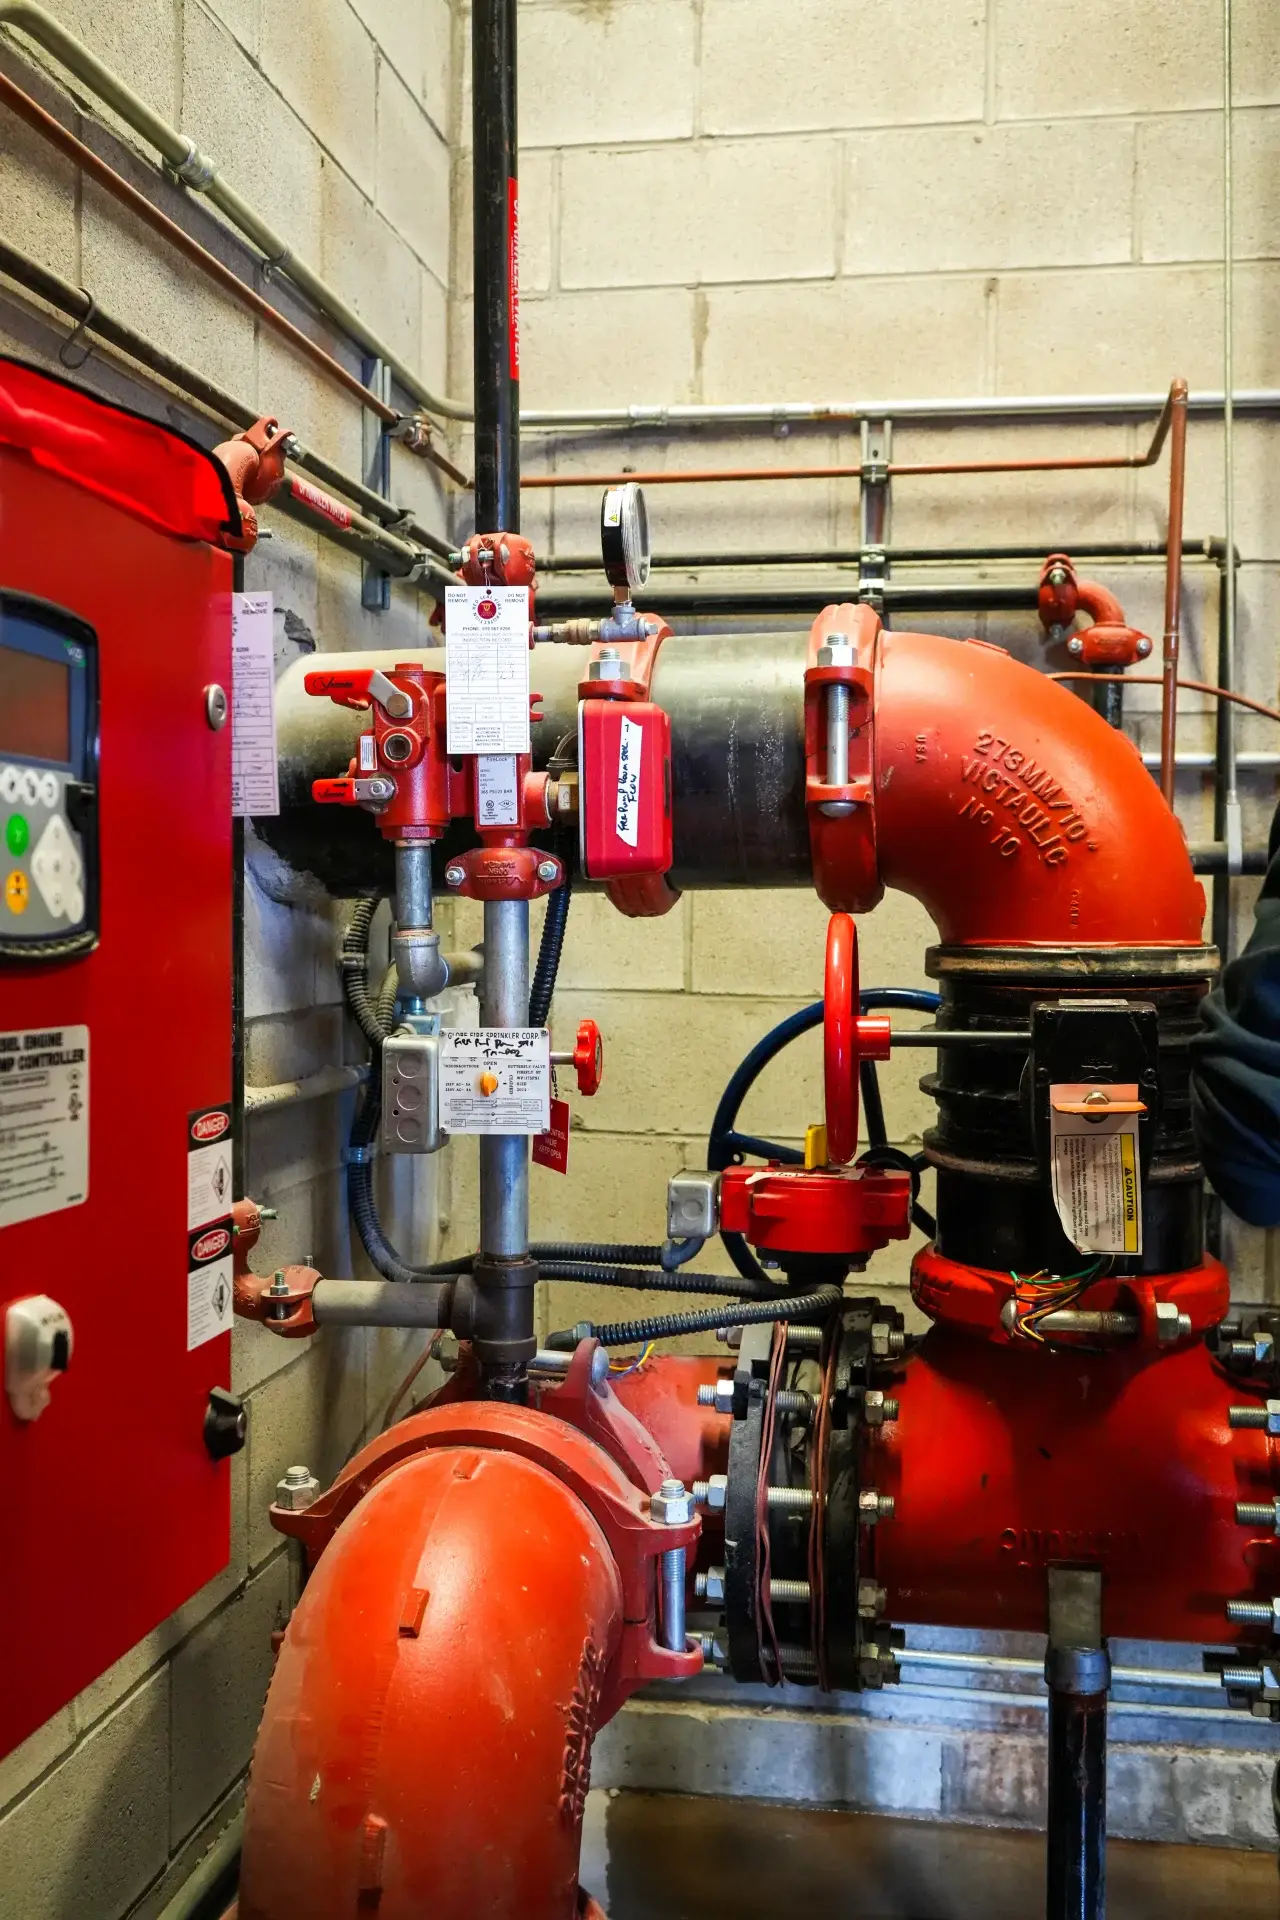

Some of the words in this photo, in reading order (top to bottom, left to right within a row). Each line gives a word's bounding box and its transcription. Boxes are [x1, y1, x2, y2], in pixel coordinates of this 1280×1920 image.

[960, 756, 1069, 866] VICTAULIC
[18, 1048, 86, 1070] CONTROLLER
[196, 1115, 226, 1136] DANGER
[1126, 1178, 1134, 1221] CAUTION
[196, 1232, 226, 1256] DANGER
